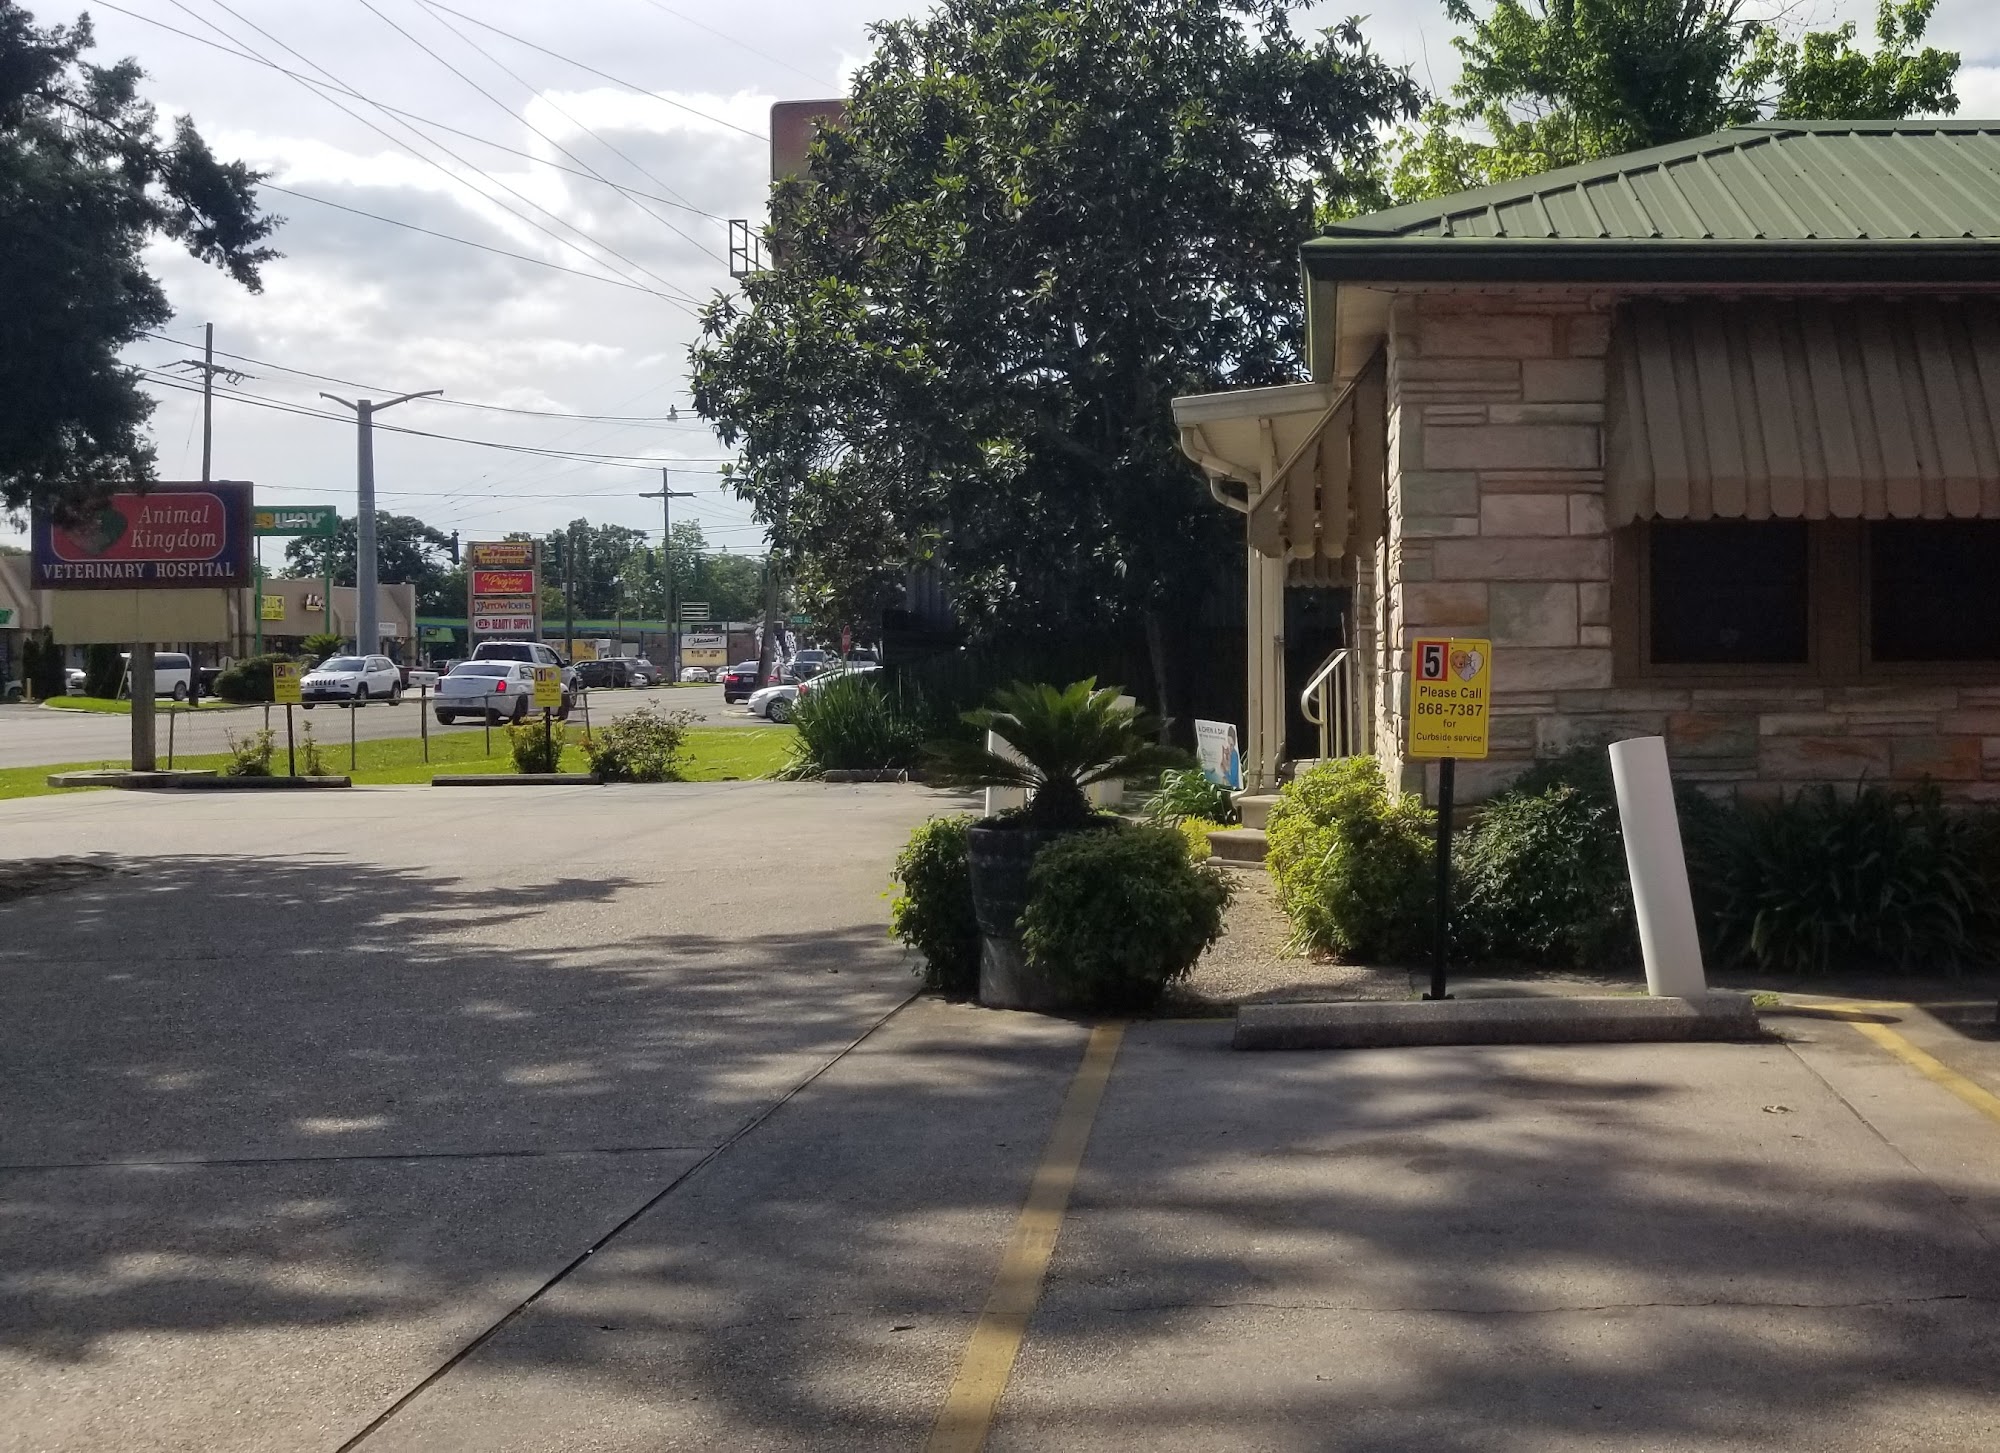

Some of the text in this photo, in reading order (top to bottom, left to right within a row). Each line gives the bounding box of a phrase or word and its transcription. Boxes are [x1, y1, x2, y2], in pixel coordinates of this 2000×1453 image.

[138, 505, 209, 524] Animal
[131, 529, 217, 553] Kingdom
[43, 562, 235, 579] VETERINARY HOSPITAL
[492, 618, 512, 629] BEAUTY
[514, 618, 532, 629] SUPPLY
[1425, 646, 1440, 678] 5
[277, 666, 284, 677] 2
[538, 669, 543, 681] 1
[1420, 686, 1482, 699] Please Call
[1417, 703, 1483, 716] 868-7387
[1443, 719, 1457, 728] for
[1416, 732, 1482, 743] Curbside service
